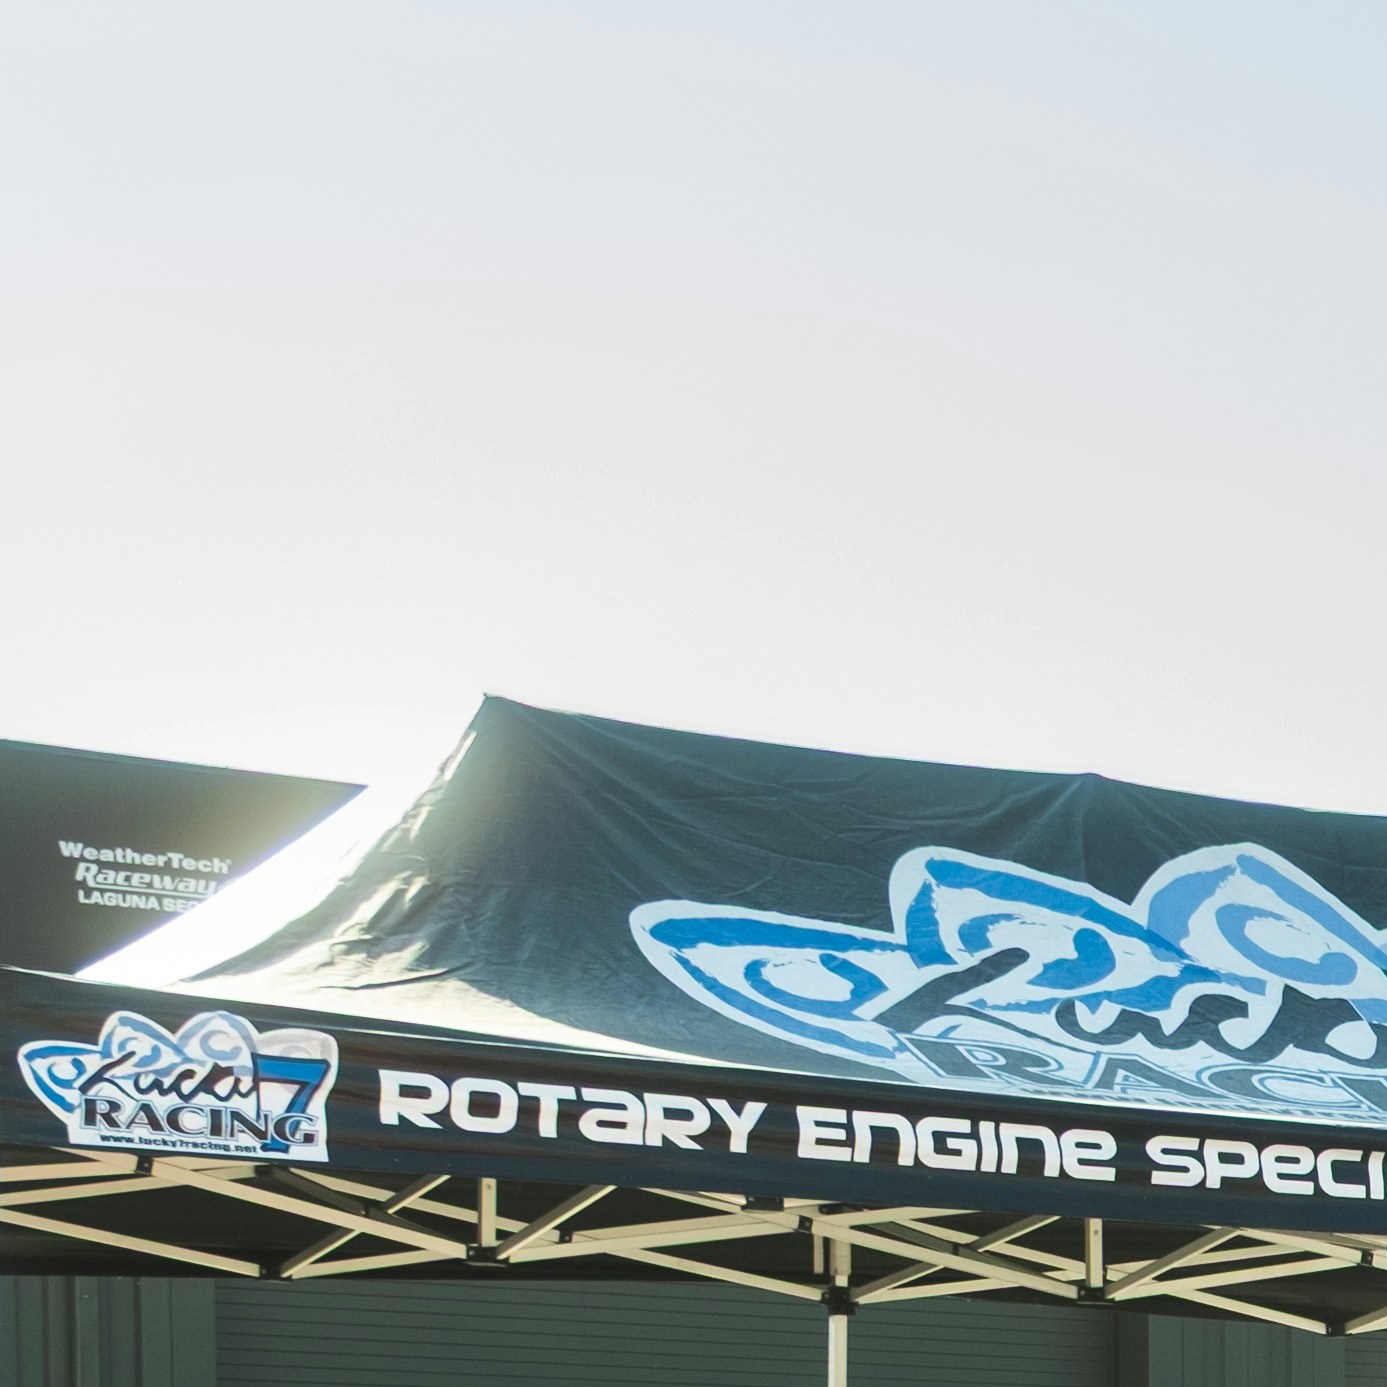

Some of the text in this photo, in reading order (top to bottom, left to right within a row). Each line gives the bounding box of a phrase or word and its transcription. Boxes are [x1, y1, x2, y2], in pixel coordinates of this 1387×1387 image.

[58, 840, 230, 875] WeatherTech
[75, 861, 217, 899] Raceway
[78, 890, 161, 912] LAGUNA
[79, 1095, 320, 1147] RACING
